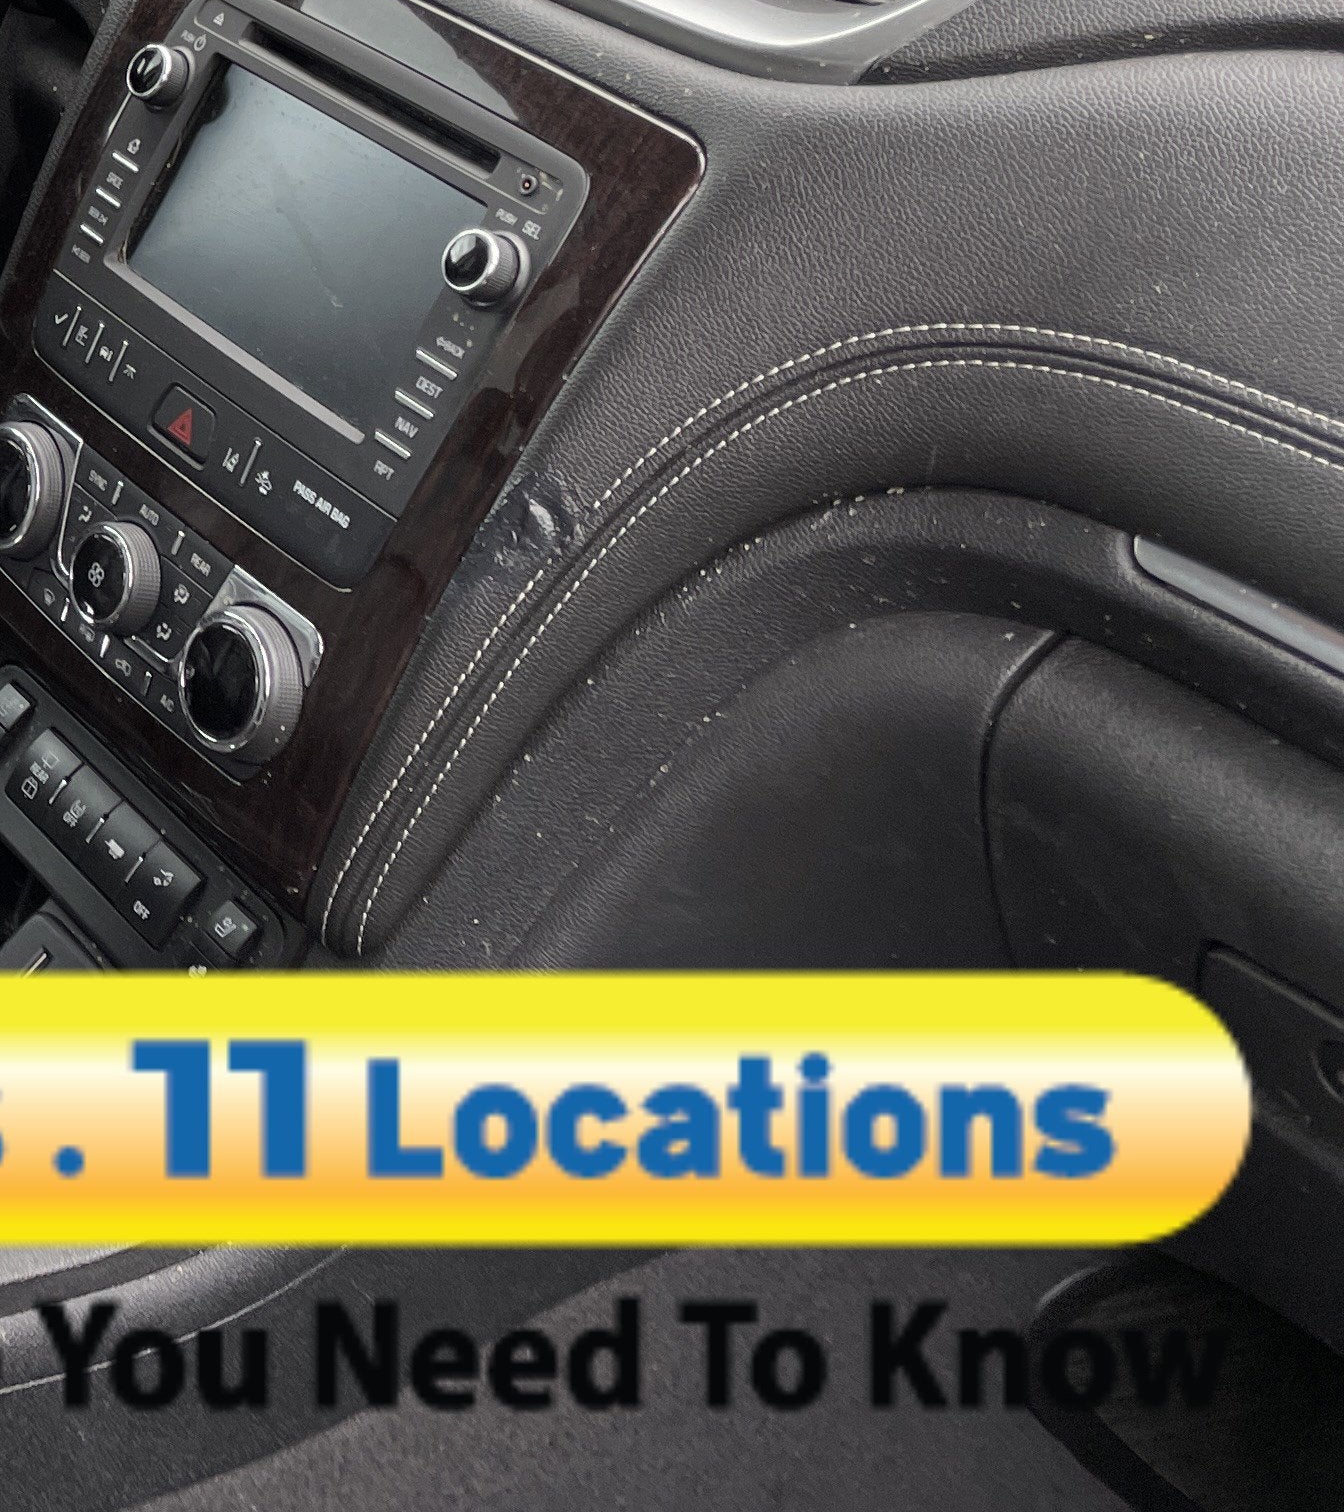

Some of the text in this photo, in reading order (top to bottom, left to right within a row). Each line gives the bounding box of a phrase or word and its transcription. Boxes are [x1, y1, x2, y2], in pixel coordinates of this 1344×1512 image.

[522, 219, 542, 241] SEL
[415, 375, 444, 398] DEST
[394, 416, 419, 438] NAV
[293, 479, 350, 530] PASS AIR BAG
